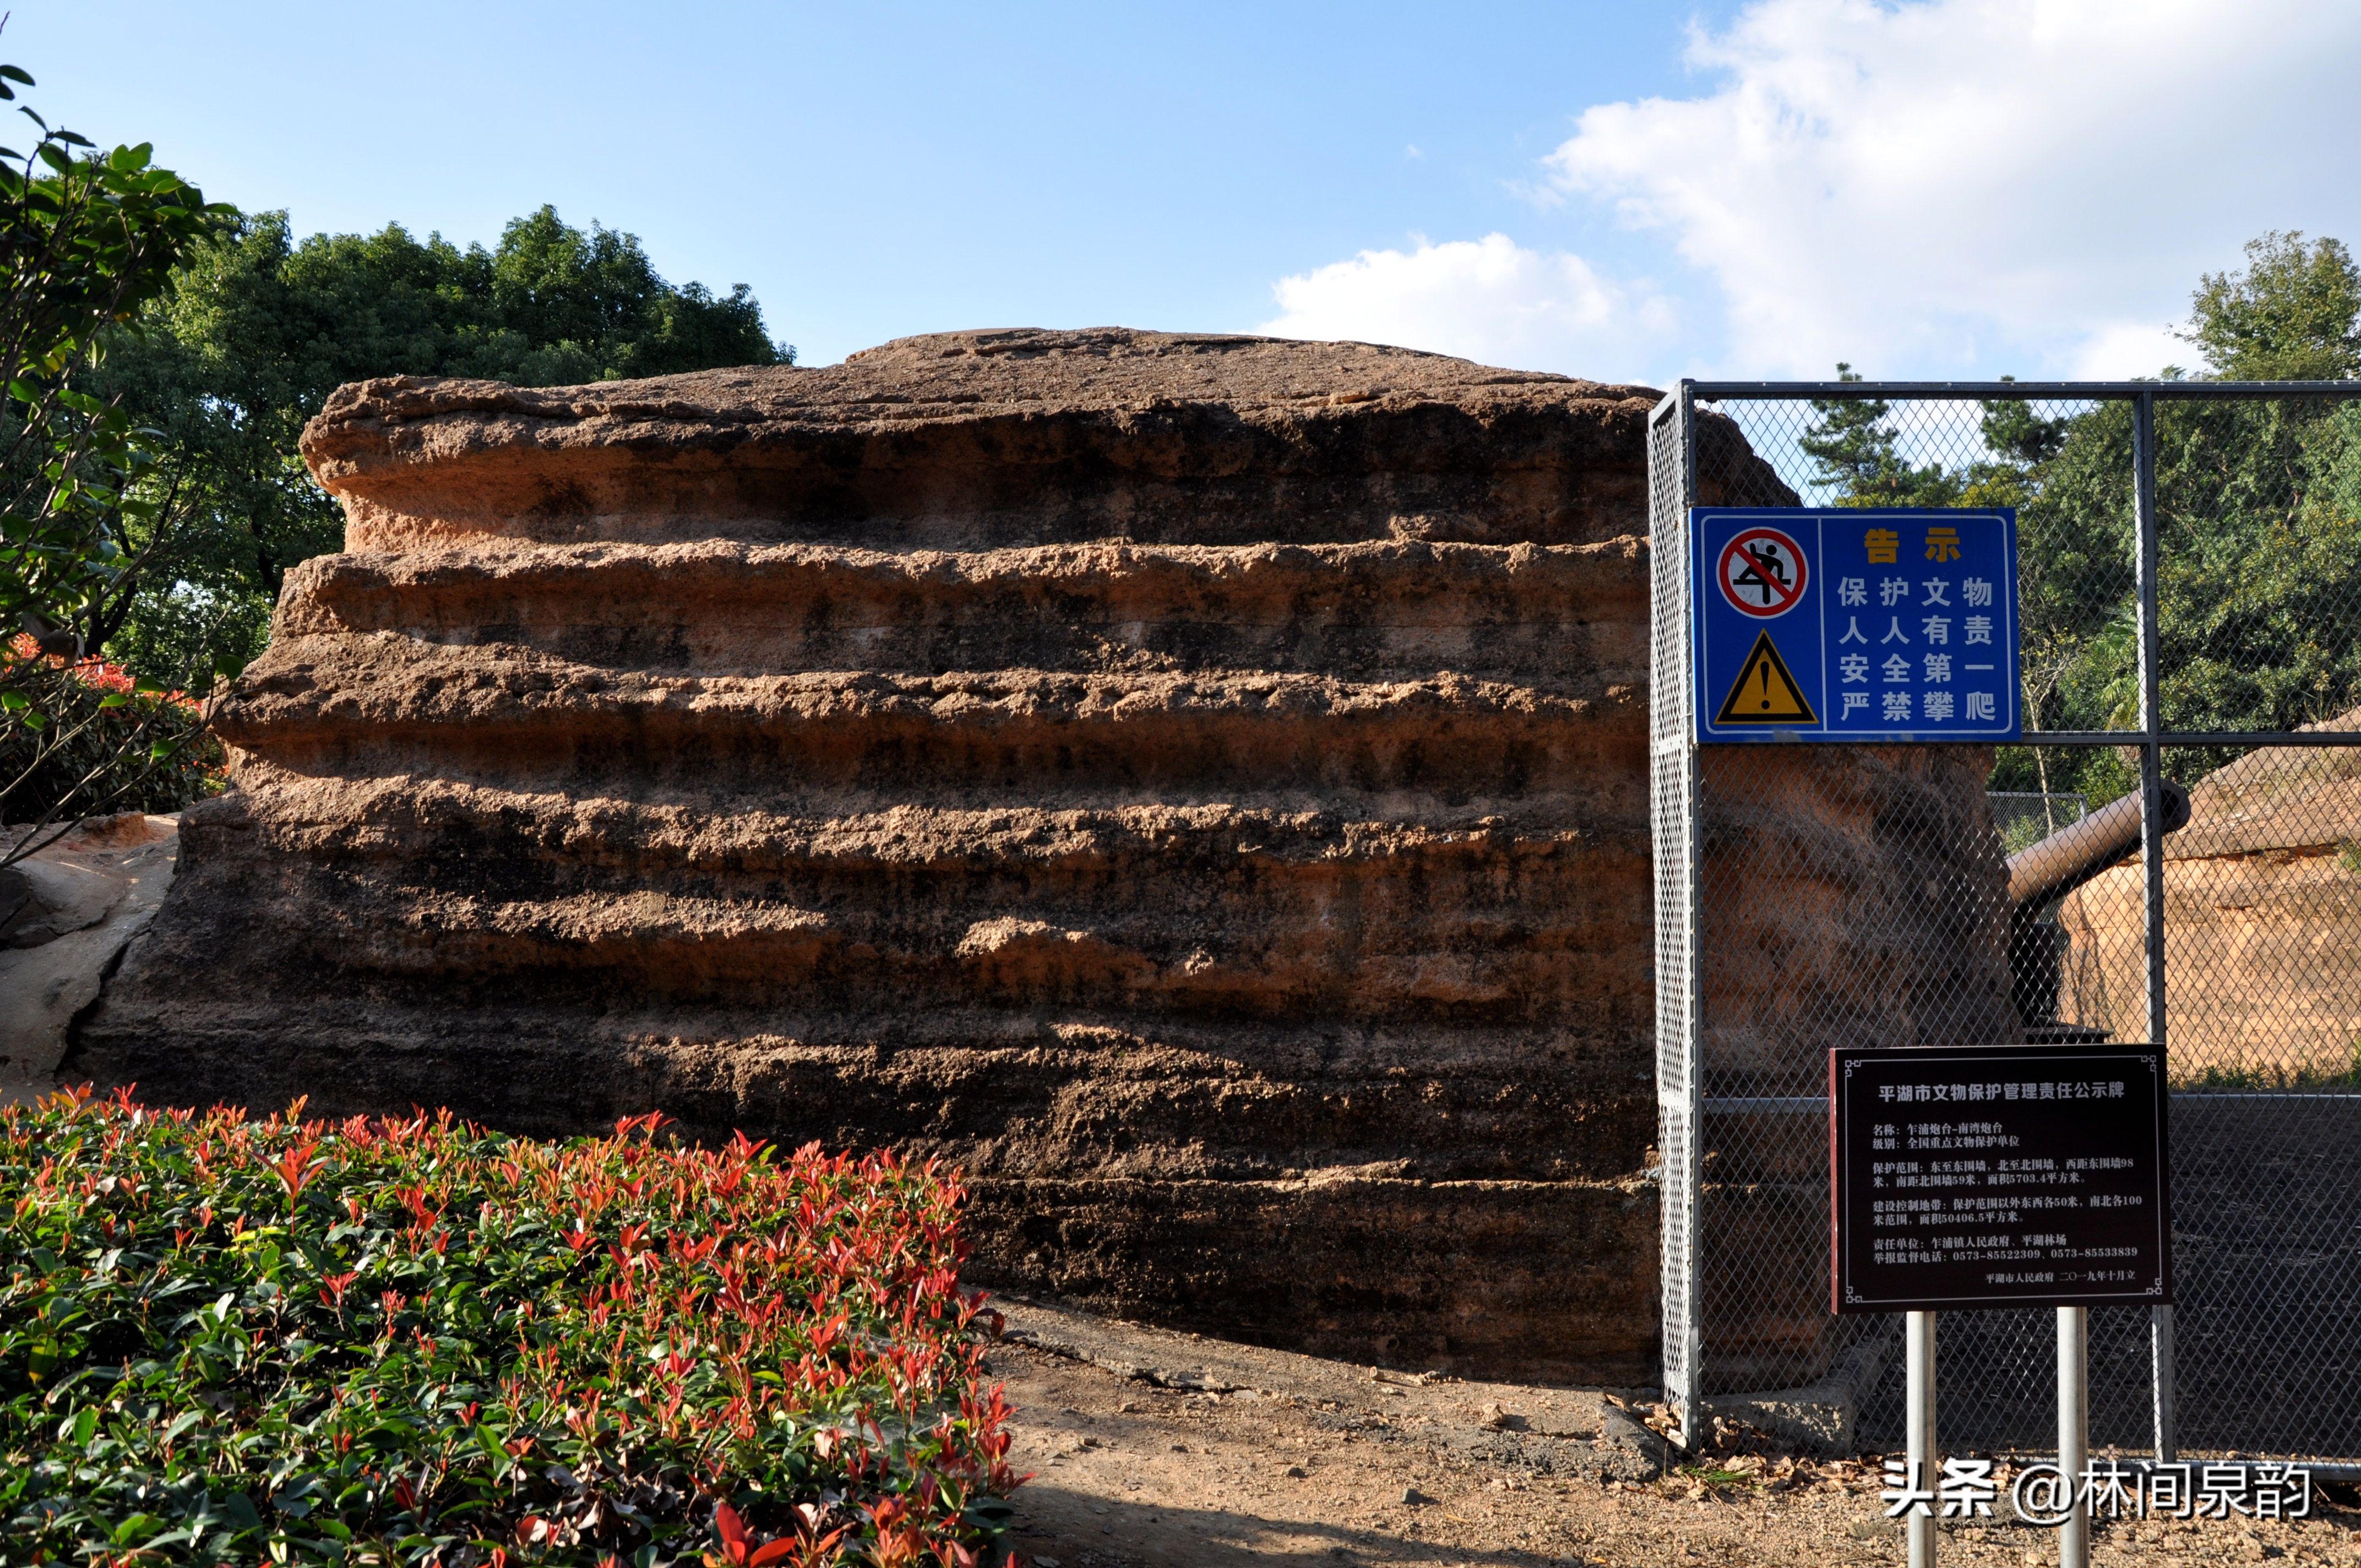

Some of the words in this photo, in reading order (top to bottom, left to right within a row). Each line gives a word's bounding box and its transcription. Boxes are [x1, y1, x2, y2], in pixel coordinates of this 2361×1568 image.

[1864, 527, 1961, 564] 告示
[1837, 577, 1992, 606] 保护文物
[1838, 615, 1993, 644] 人人有责
[1839, 653, 1994, 683] 安全第一
[1840, 691, 1995, 721] 严禁攀爬
[1878, 1082, 2125, 1102] 平湖市文物保护管理责任公示牌
[1872, 1136, 2020, 1150] 级别：全国重点文物保护单位
[1985, 1272, 2054, 1284] 平湖市人民政府
